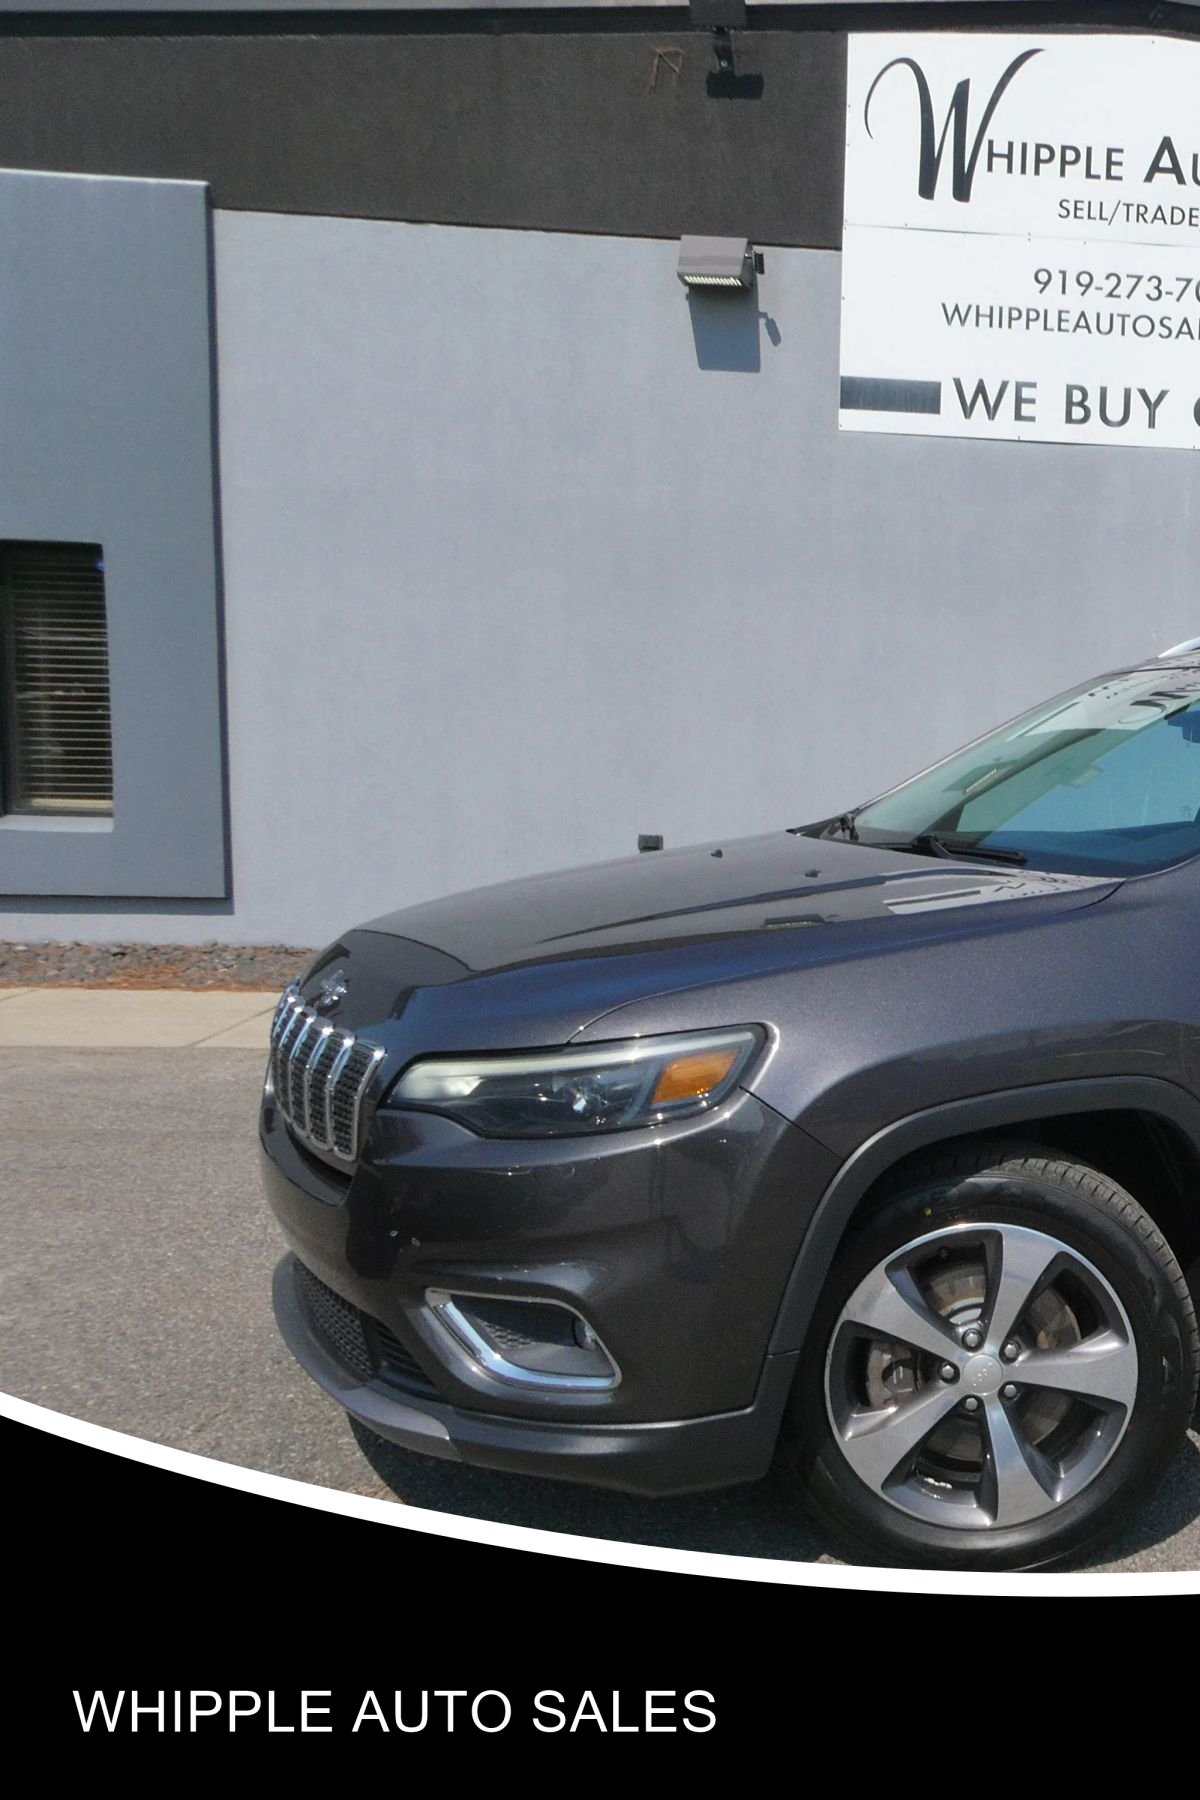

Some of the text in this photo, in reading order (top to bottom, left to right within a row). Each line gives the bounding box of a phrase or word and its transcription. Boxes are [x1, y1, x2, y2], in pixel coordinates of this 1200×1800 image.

[864, 48, 1125, 203] WHIPPLE
[952, 377, 1038, 423] WE
[1064, 383, 1170, 429] BUY
